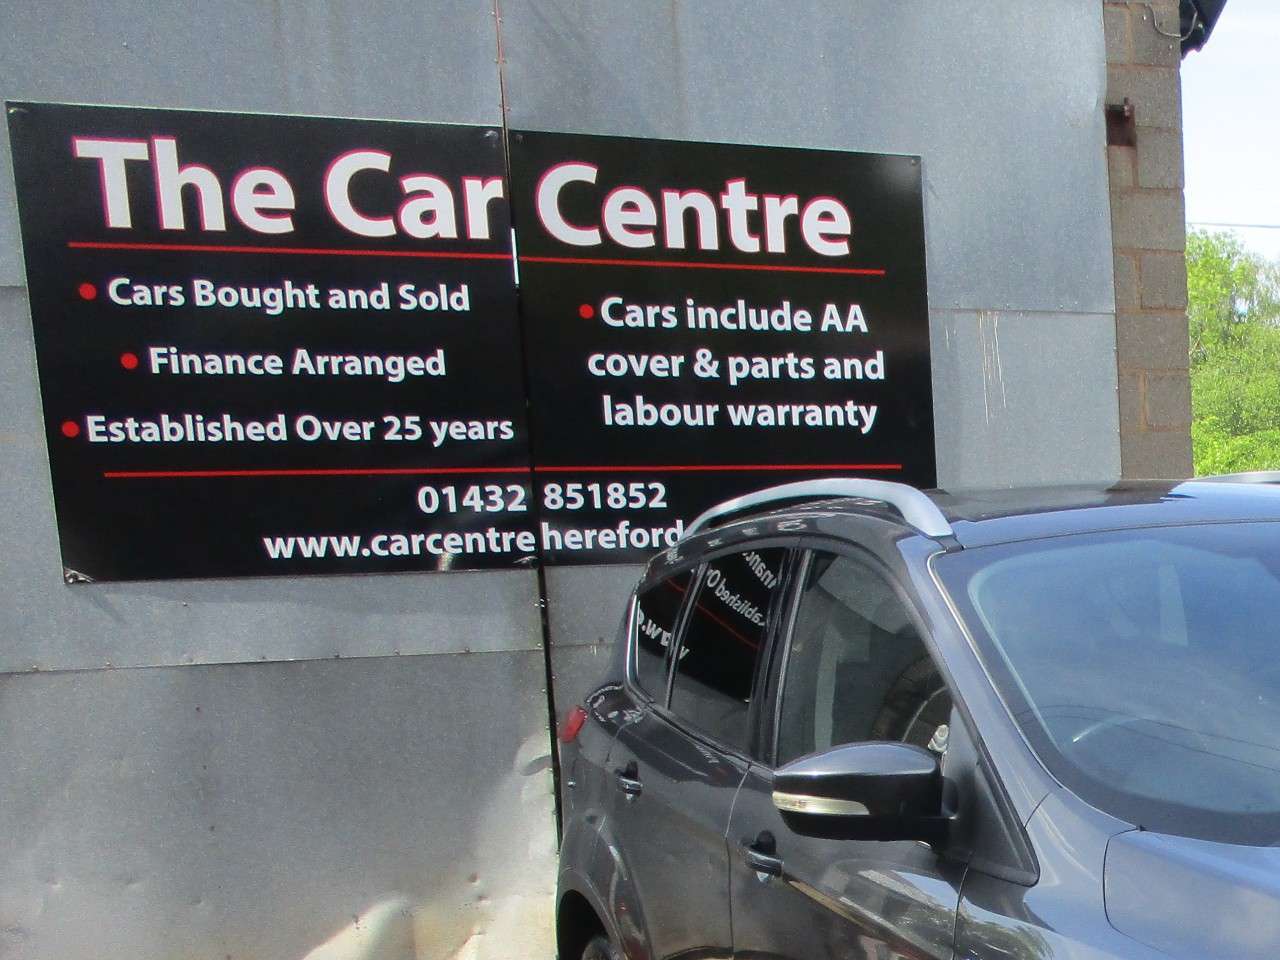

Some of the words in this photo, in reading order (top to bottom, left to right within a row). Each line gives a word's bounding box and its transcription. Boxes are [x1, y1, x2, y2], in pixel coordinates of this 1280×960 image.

[72, 135, 296, 234] The
[323, 149, 505, 240] Car
[535, 161, 852, 257] Centre
[108, 278, 185, 306] Cars
[193, 280, 321, 314] Bought
[328, 283, 391, 310] and
[400, 283, 471, 312] Sold
[600, 297, 678, 329] Cars
[687, 299, 812, 332] include
[820, 303, 868, 333] AA
[150, 347, 283, 376] Finance
[292, 349, 447, 382] Arranged
[587, 350, 684, 377] cover
[693, 348, 720, 379] &
[728, 351, 816, 386] parts
[823, 350, 885, 380] and
[86, 414, 287, 443] Established
[296, 416, 375, 441] Over
[383, 416, 422, 440] 25
[430, 419, 514, 447] years
[603, 395, 720, 427] labour
[727, 400, 878, 434] warranty
[417, 485, 528, 514] 01432
[543, 482, 668, 510] 851852
